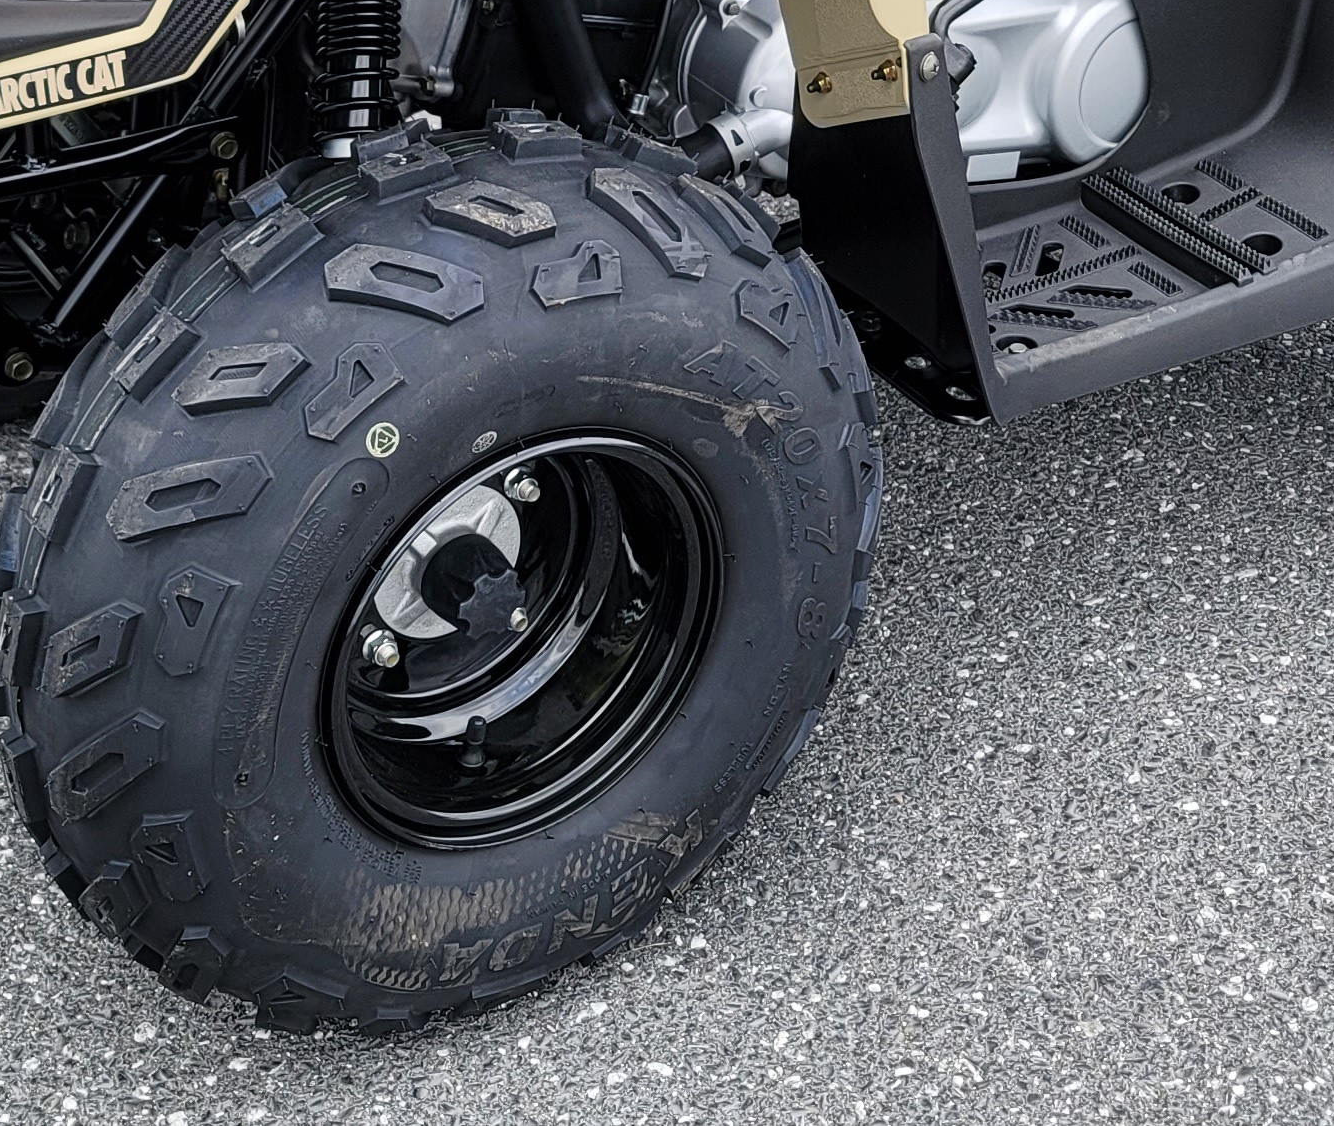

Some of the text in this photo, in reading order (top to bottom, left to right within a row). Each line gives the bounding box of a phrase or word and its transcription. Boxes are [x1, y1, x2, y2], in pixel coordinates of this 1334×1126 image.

[76, 50, 127, 95] CAT
[760, 662, 793, 717] NYLON
[439, 806, 711, 982] KENDA
